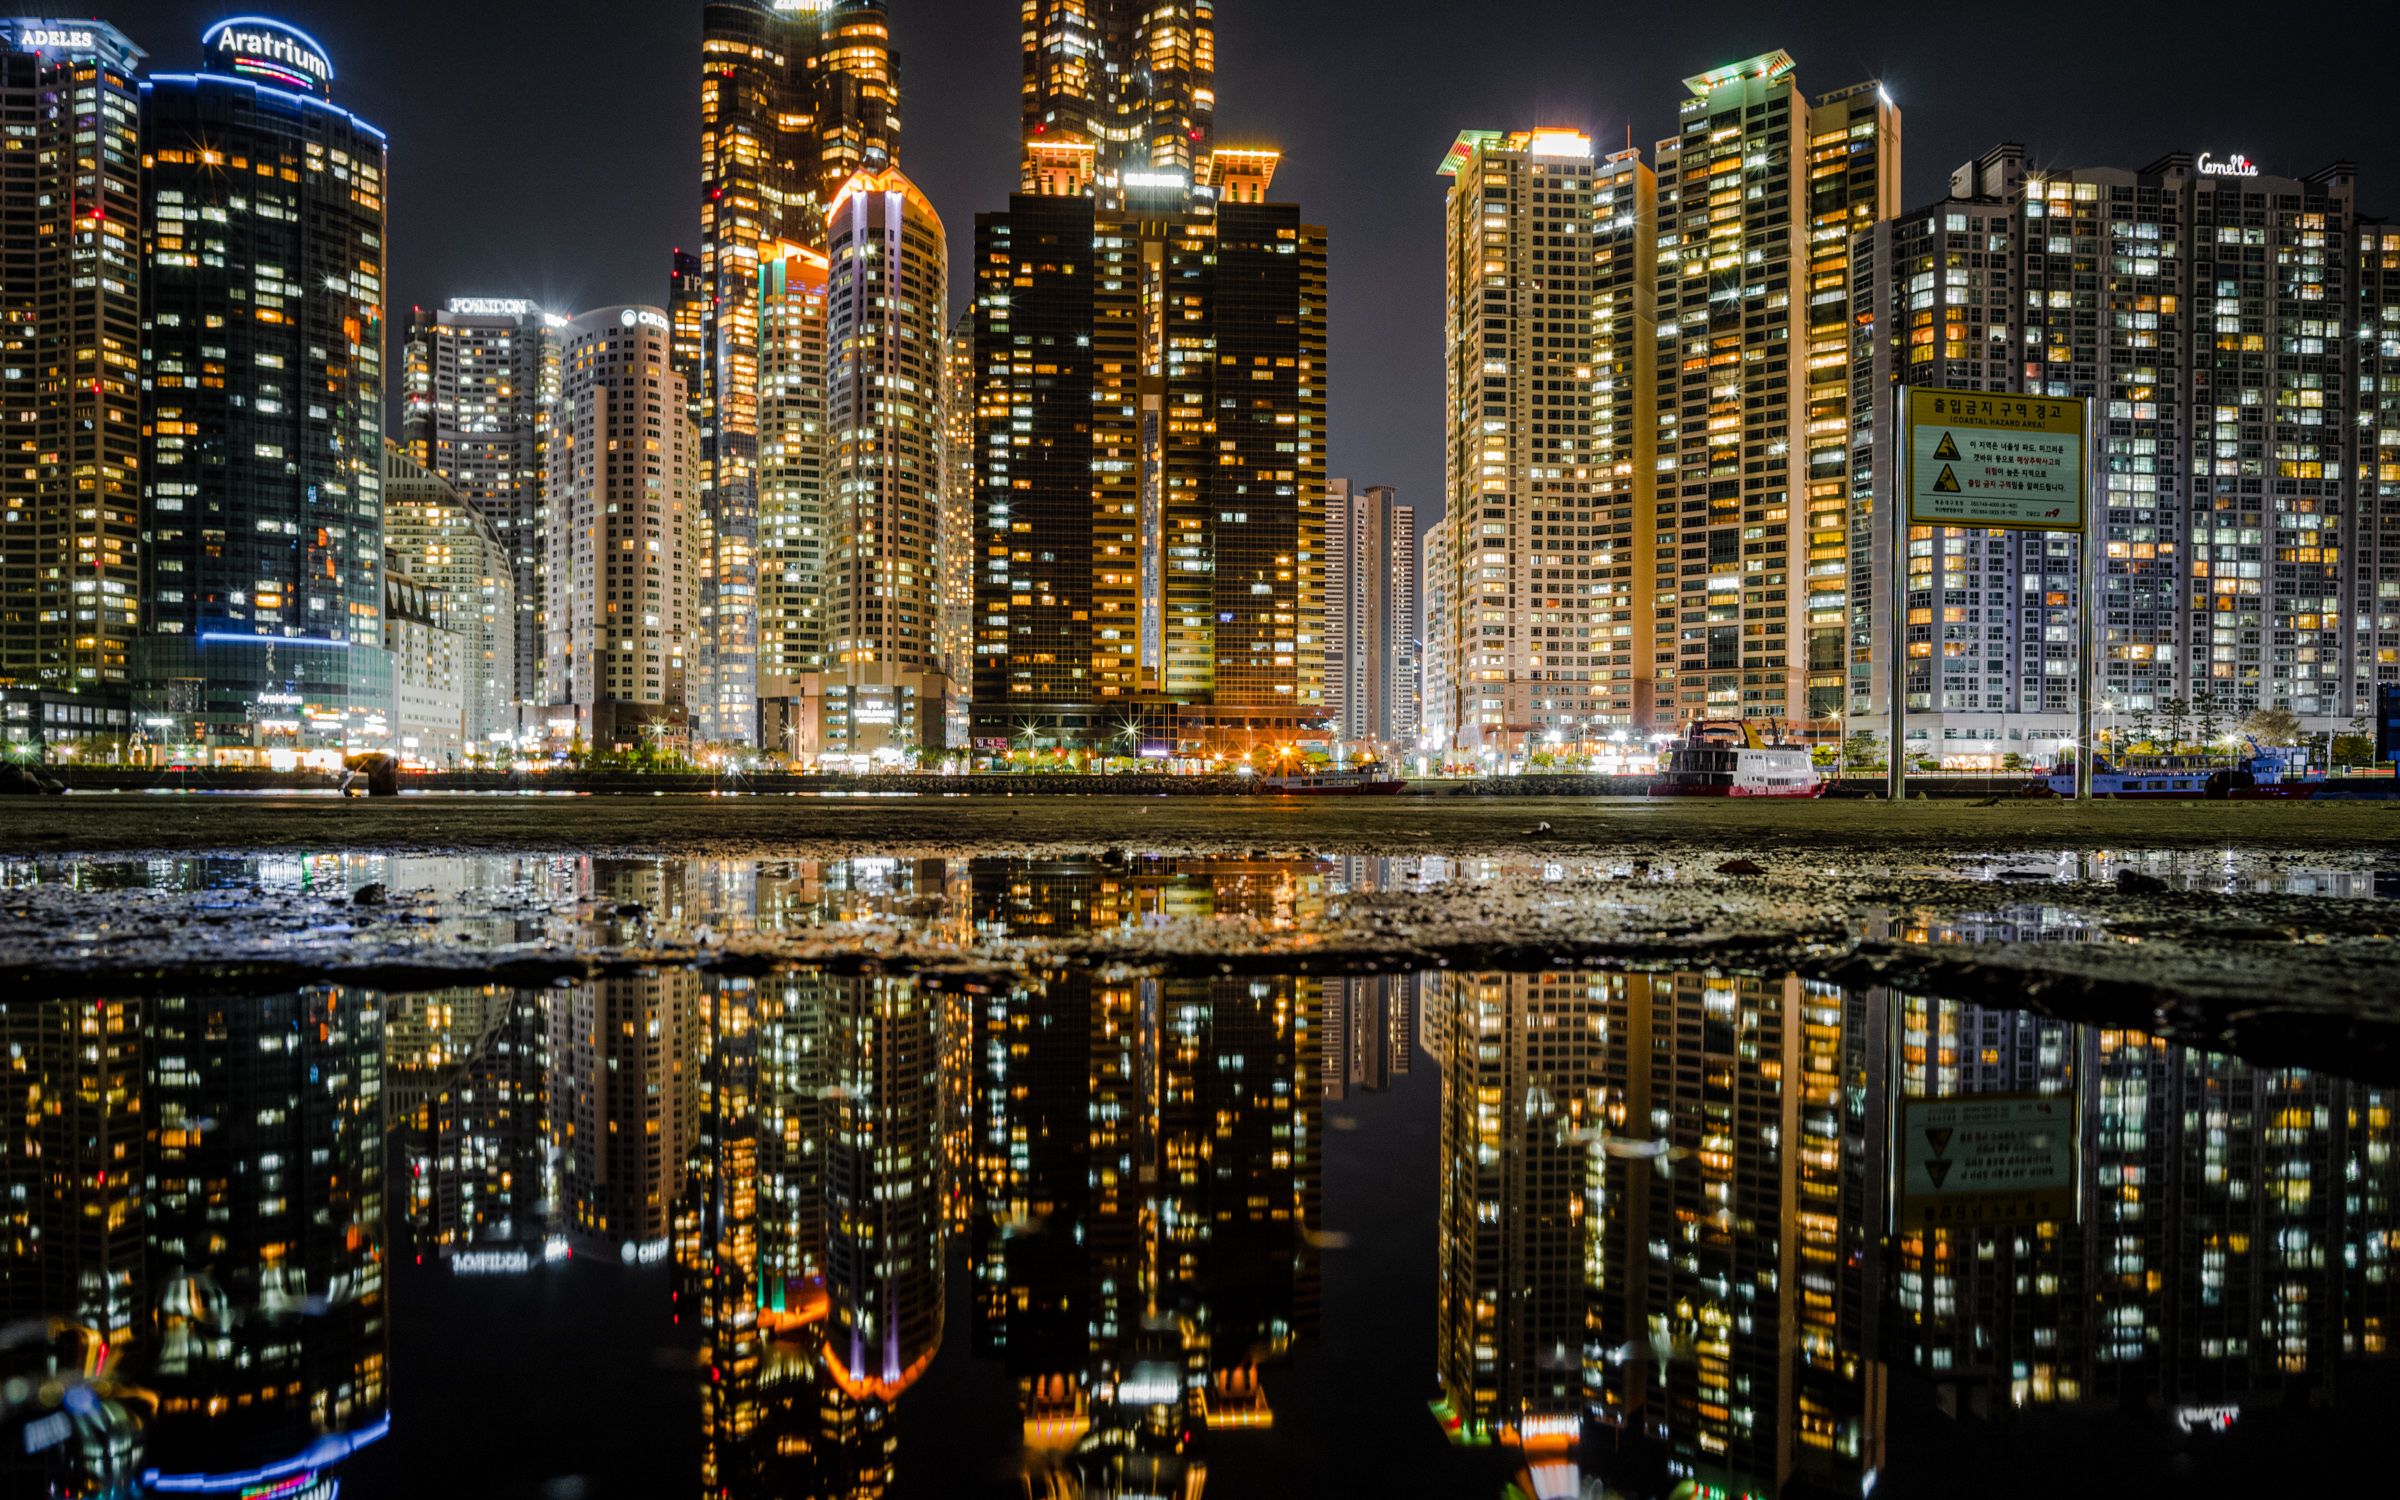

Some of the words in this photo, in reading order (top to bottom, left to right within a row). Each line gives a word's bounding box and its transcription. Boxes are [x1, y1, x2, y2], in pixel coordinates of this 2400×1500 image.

[21, 29, 92, 47] ADELES
[218, 26, 327, 80] Aratrium
[2197, 152, 2259, 177] Camellia
[1934, 398, 1992, 416] 출입금지
[2000, 402, 2026, 418] 구역
[2036, 404, 2062, 419] 경고
[1990, 418, 2020, 427] HAZARD
